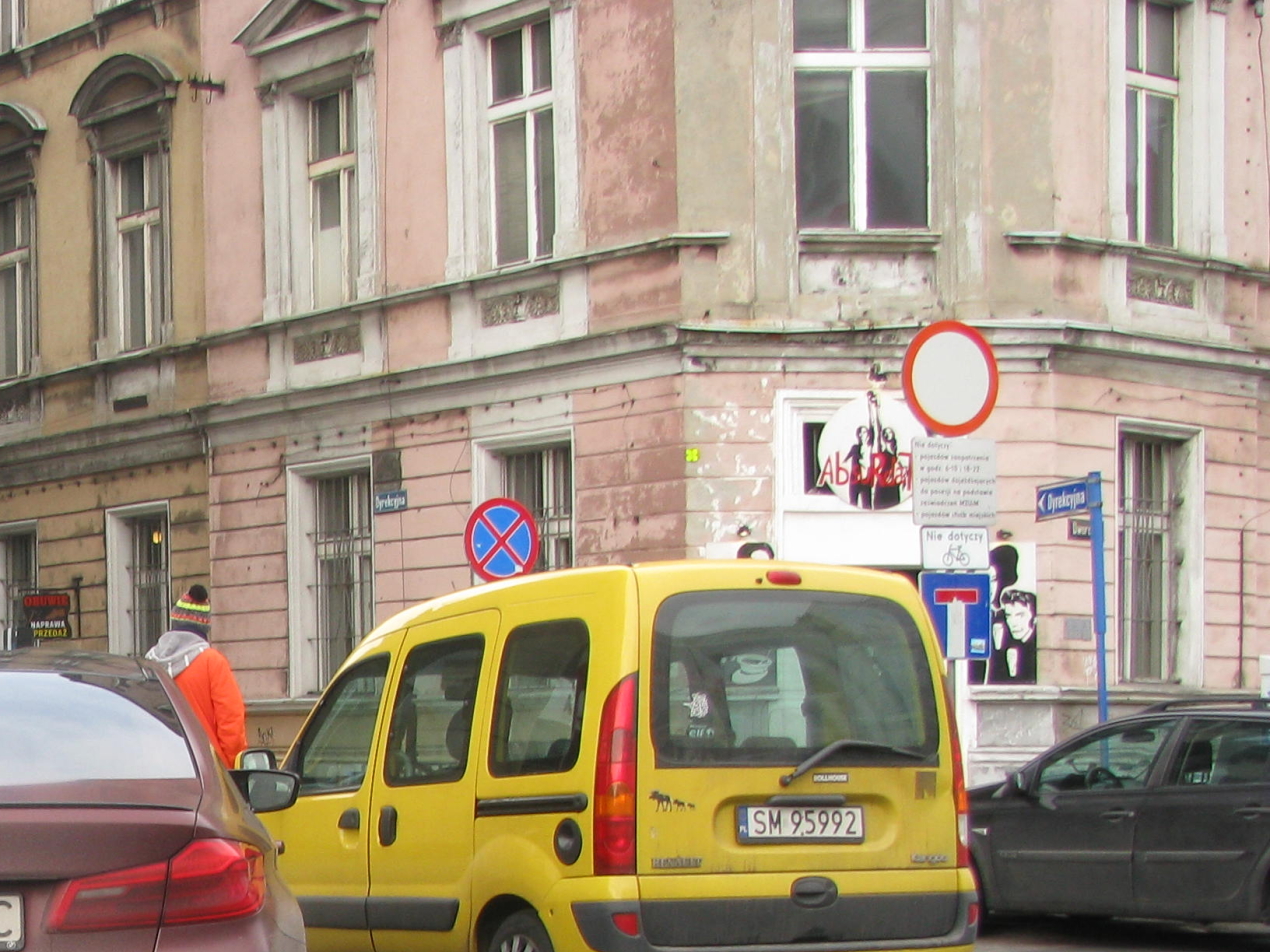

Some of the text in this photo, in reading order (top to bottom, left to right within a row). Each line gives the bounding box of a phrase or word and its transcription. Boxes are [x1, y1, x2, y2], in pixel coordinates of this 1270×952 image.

[1047, 487, 1086, 514] Dyrekcyjna
[926, 531, 984, 544] Nie dotyczy
[30, 620, 66, 629] NAPRAWA
[739, 810, 857, 834] PL SM 95992
